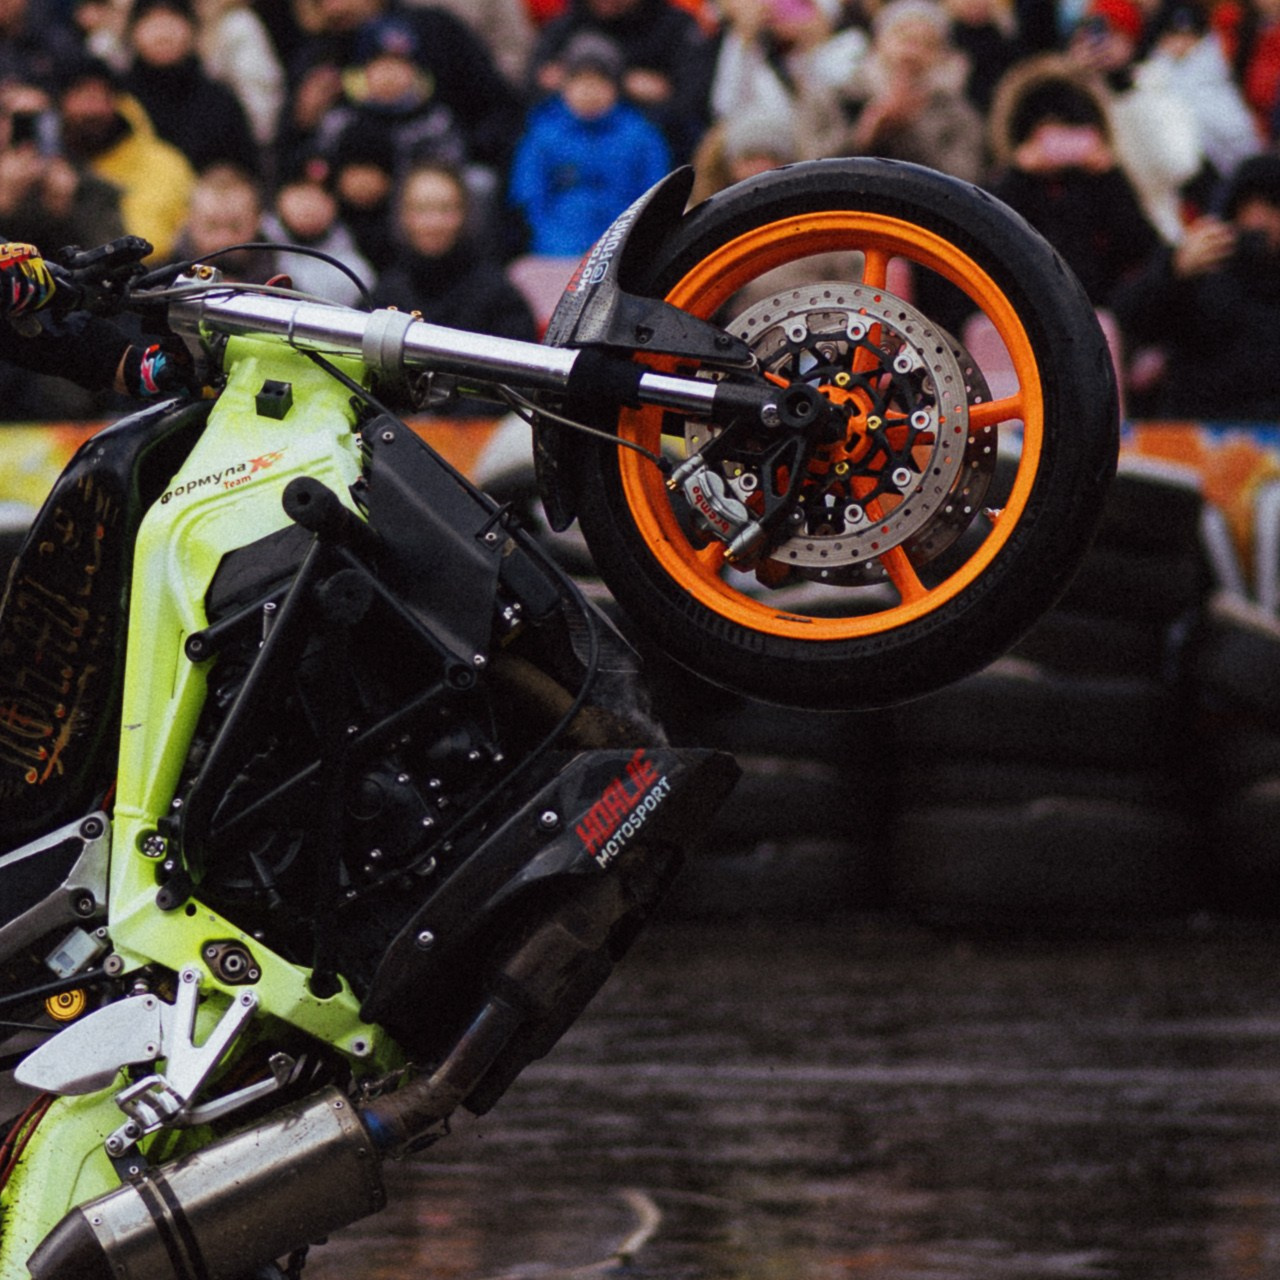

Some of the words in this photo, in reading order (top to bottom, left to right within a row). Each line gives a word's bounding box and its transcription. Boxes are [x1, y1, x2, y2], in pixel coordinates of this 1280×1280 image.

[224, 475, 251, 489] Team
[693, 485, 730, 534] brembo
[595, 776, 671, 869] MOTOSPORT
